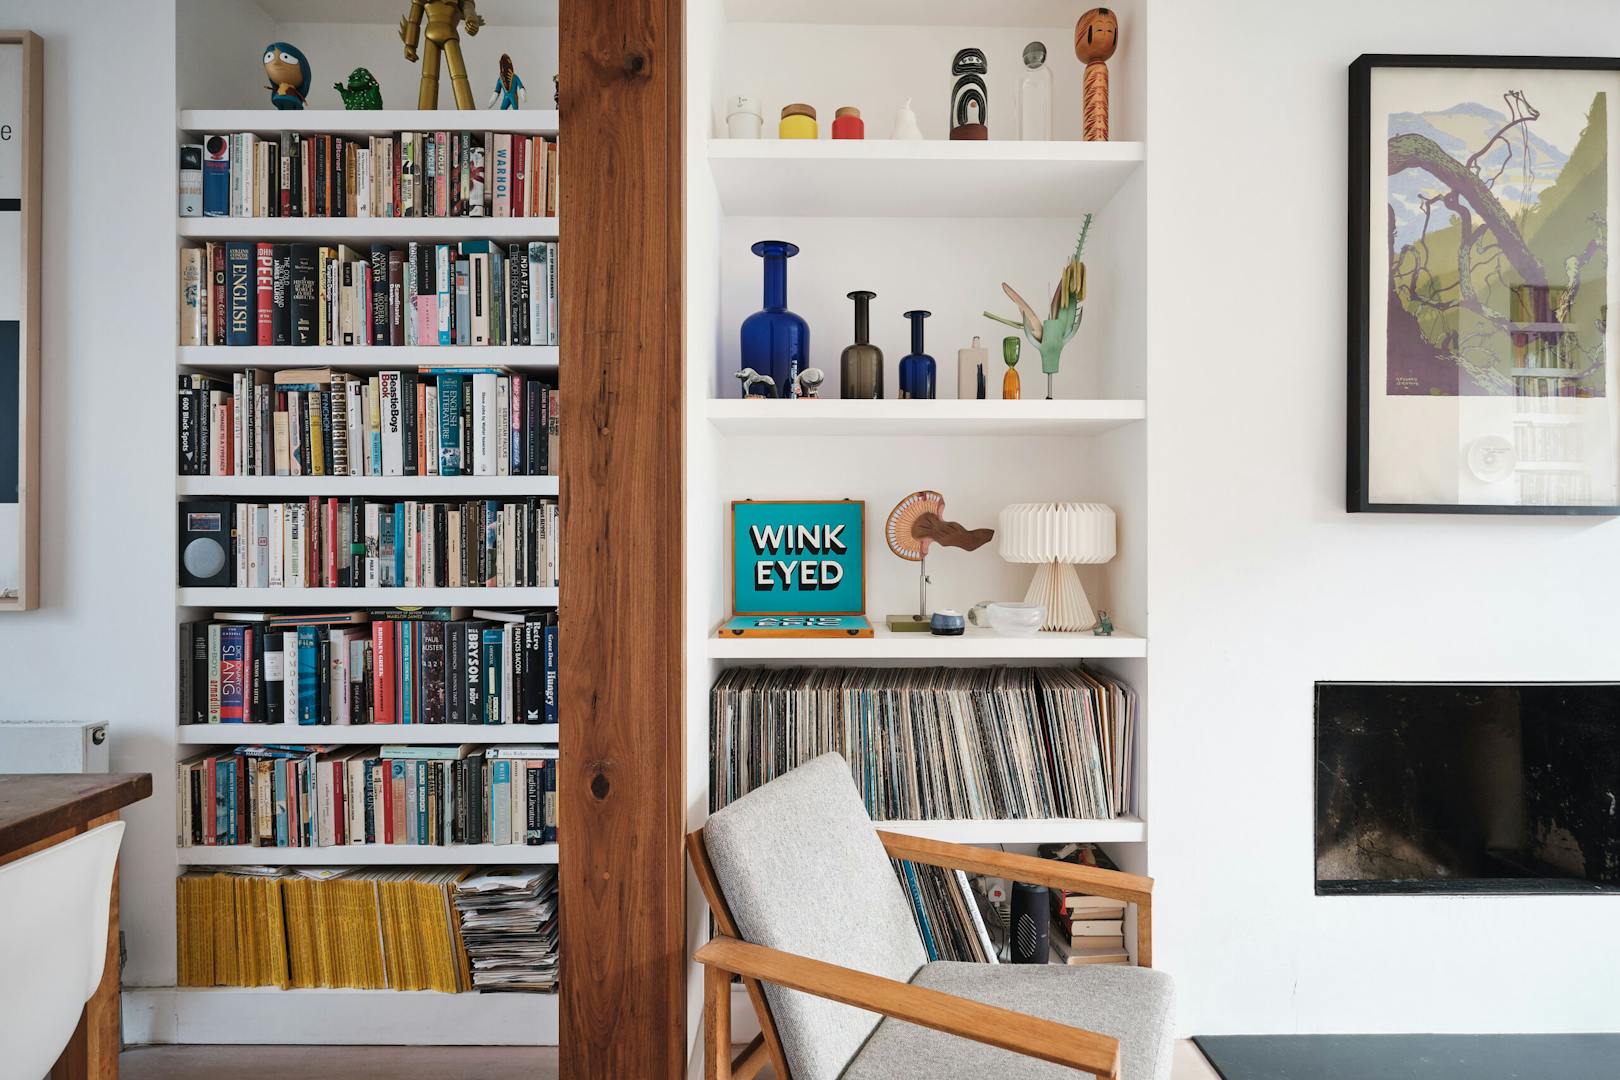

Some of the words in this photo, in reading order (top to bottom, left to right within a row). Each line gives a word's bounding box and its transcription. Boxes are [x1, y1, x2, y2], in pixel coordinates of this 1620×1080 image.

[496, 150, 506, 198] WARHOL
[257, 256, 273, 294] PEEL
[372, 252, 380, 282] MARR
[520, 256, 528, 278] INDIA
[232, 264, 248, 334] ENGLISH
[381, 374, 390, 398] Book
[322, 393, 331, 432] PYNCHON
[181, 432, 190, 452] Spots
[749, 525, 847, 555] WINK
[753, 561, 844, 591] EYED
[223, 645, 236, 696] SLANG
[468, 633, 479, 683] BRYSON
[210, 680, 219, 714] armadillo
[236, 686, 242, 696] OF
[545, 670, 556, 706] Hungry
[528, 770, 537, 794] English
[528, 795, 537, 827] Literature
